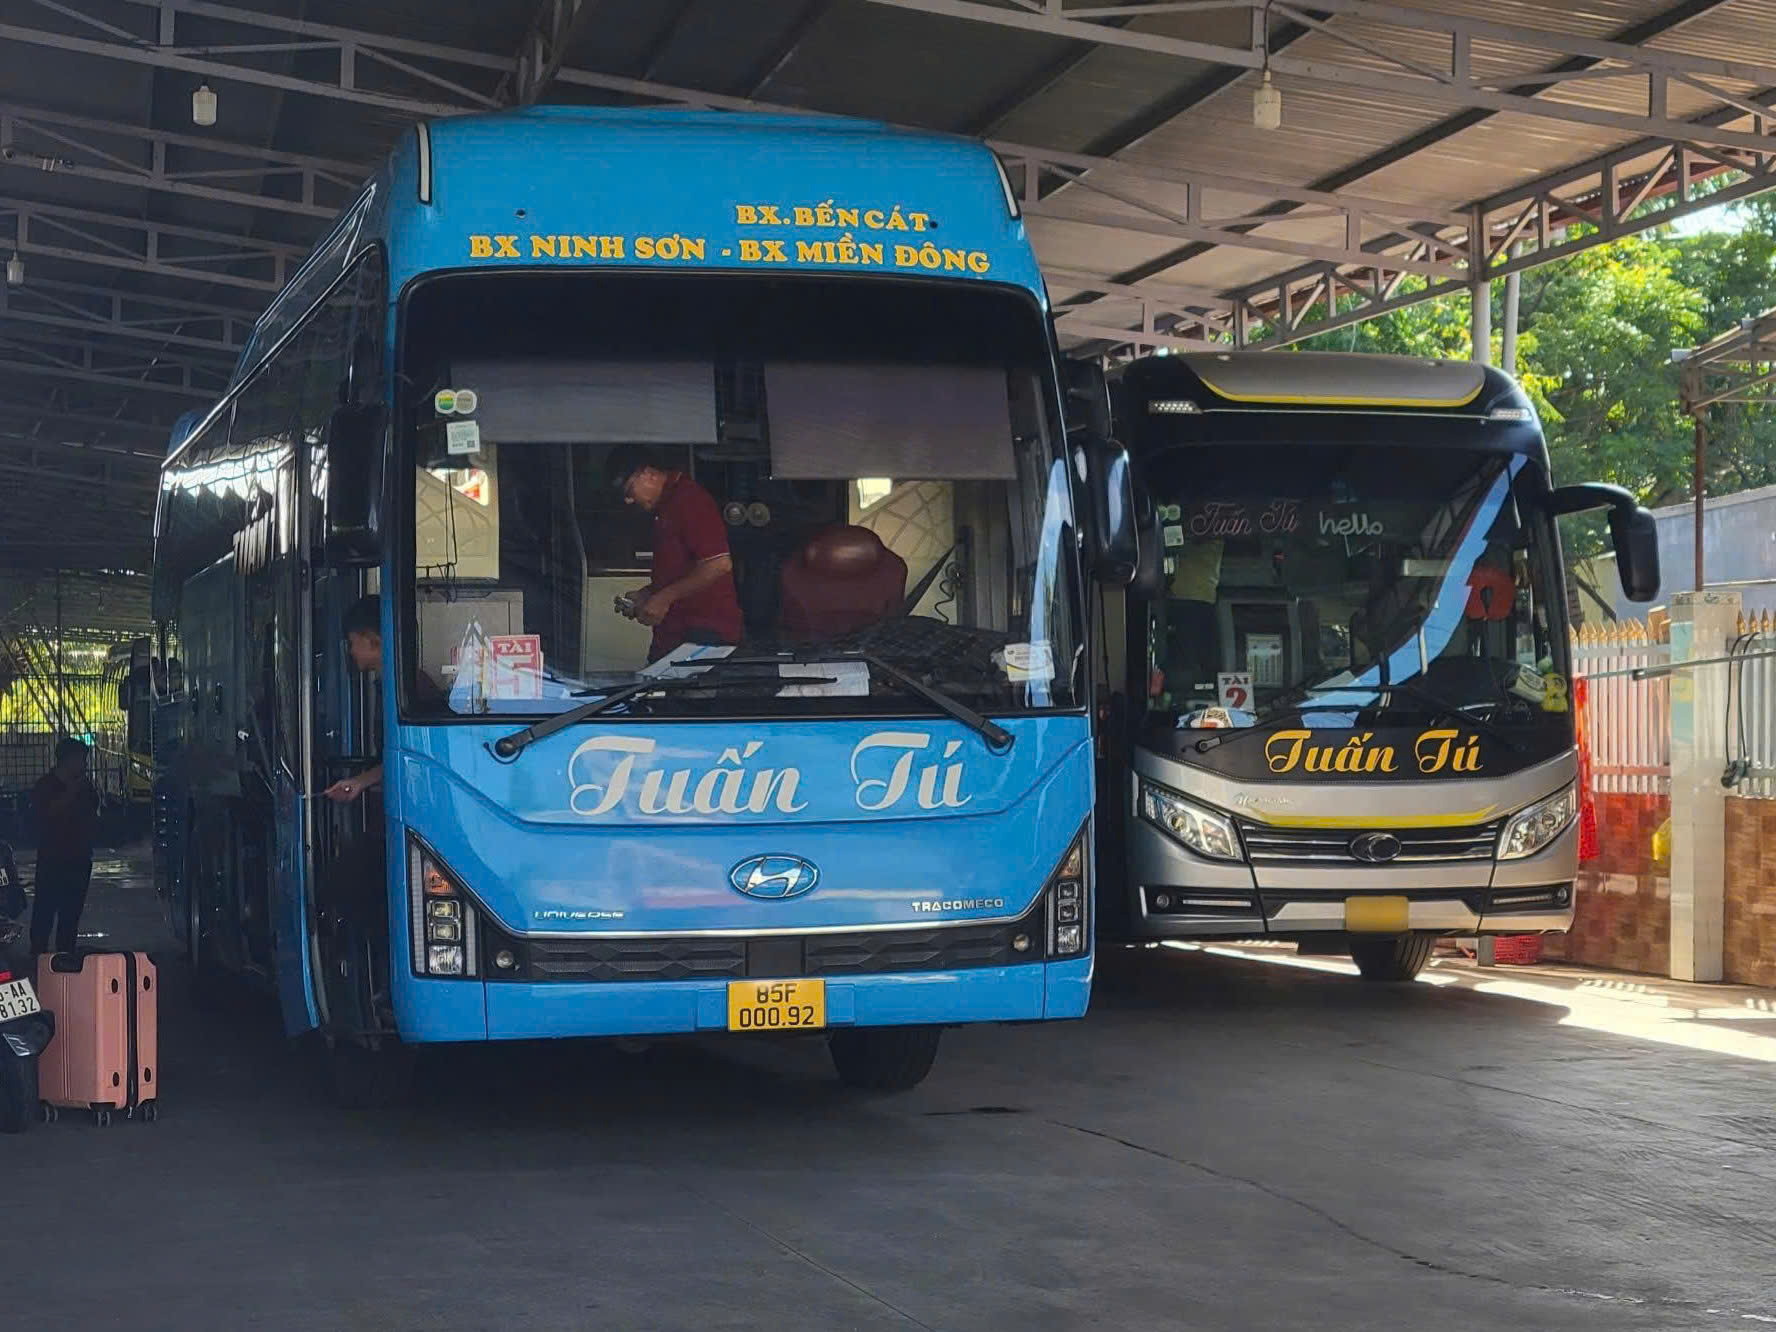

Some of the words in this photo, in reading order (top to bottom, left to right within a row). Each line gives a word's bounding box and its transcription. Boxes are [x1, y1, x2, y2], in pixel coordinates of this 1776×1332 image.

[864, 204, 929, 232] CÁT
[469, 235, 521, 257] BX
[529, 235, 625, 258] NINH
[634, 234, 706, 260] SƠN
[738, 239, 788, 262] BX
[795, 232, 884, 265] MIỀN
[894, 241, 991, 273] ĐÔNG
[1318, 511, 1384, 535] hello
[1265, 729, 1399, 773] Tuấn
[1415, 729, 1484, 774] Tú
[568, 735, 809, 816] Tuấn
[850, 732, 973, 810] Tú
[911, 898, 1004, 912] TRACOMECO
[756, 983, 798, 1004] 85F
[739, 1005, 814, 1028] 000.92
